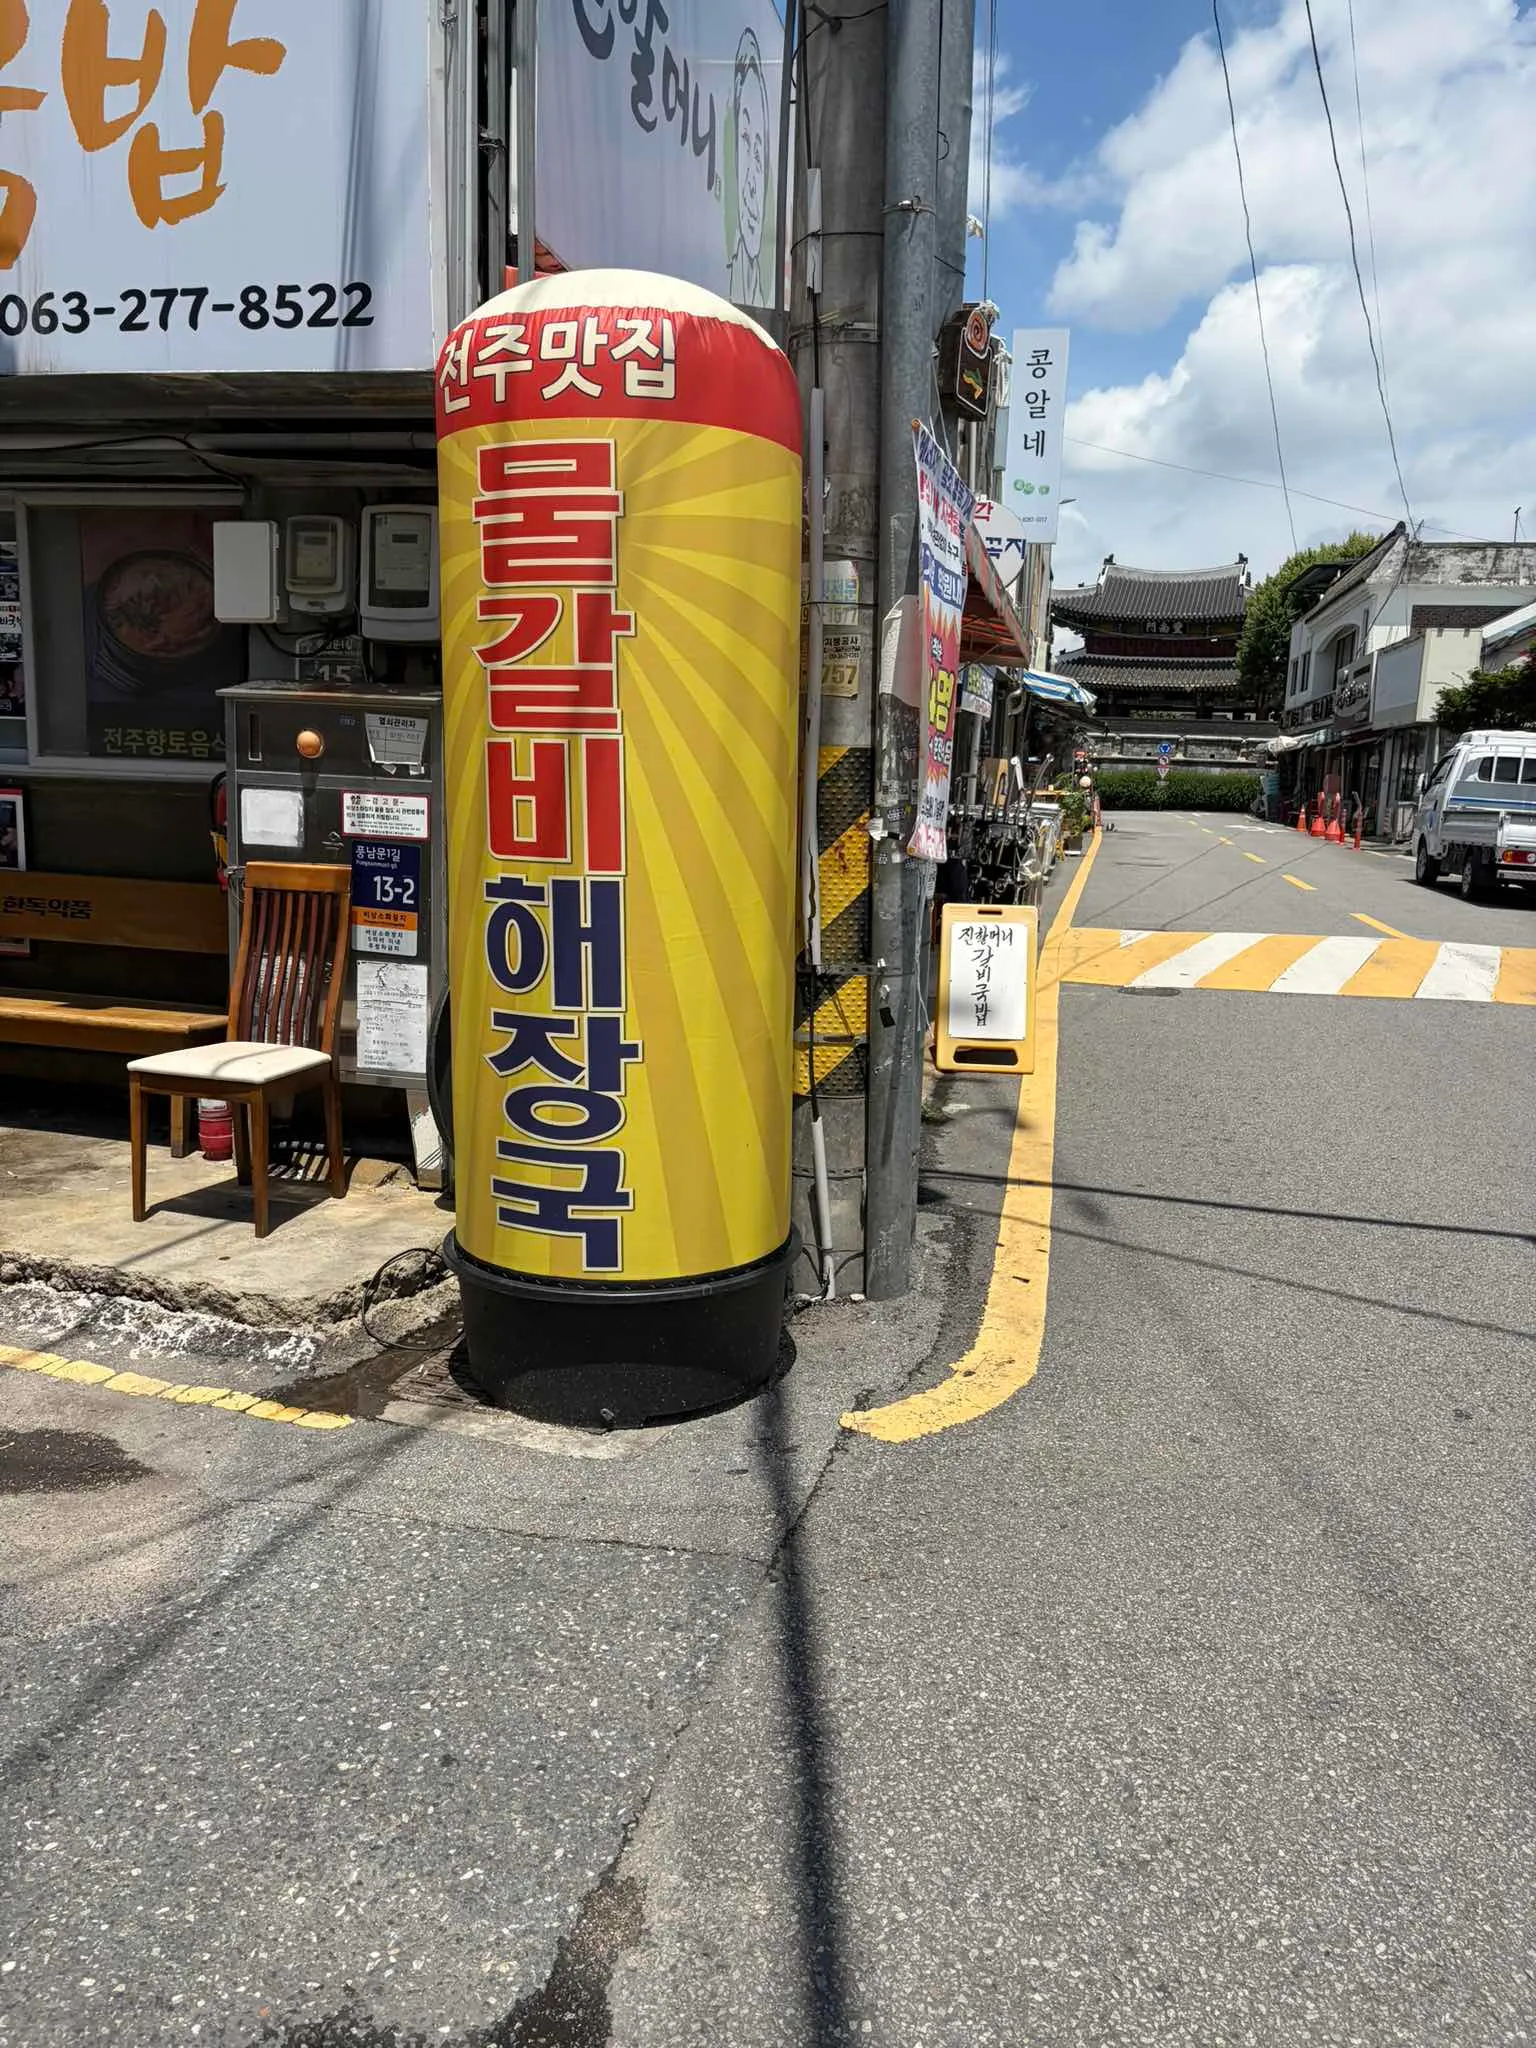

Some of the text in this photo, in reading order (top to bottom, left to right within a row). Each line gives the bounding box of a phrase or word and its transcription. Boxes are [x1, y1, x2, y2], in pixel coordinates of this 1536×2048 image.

[0, 281, 375, 336] 063-277-8522
[438, 316, 677, 414] 전주맛집
[1023, 349, 1054, 459] 콩알네
[471, 438, 636, 876] 물갈비
[355, 845, 401, 862] 풍남문1길
[373, 875, 415, 904] 13-2
[970, 946, 994, 1027] 갈비국밥
[483, 873, 643, 1272] 해장국
